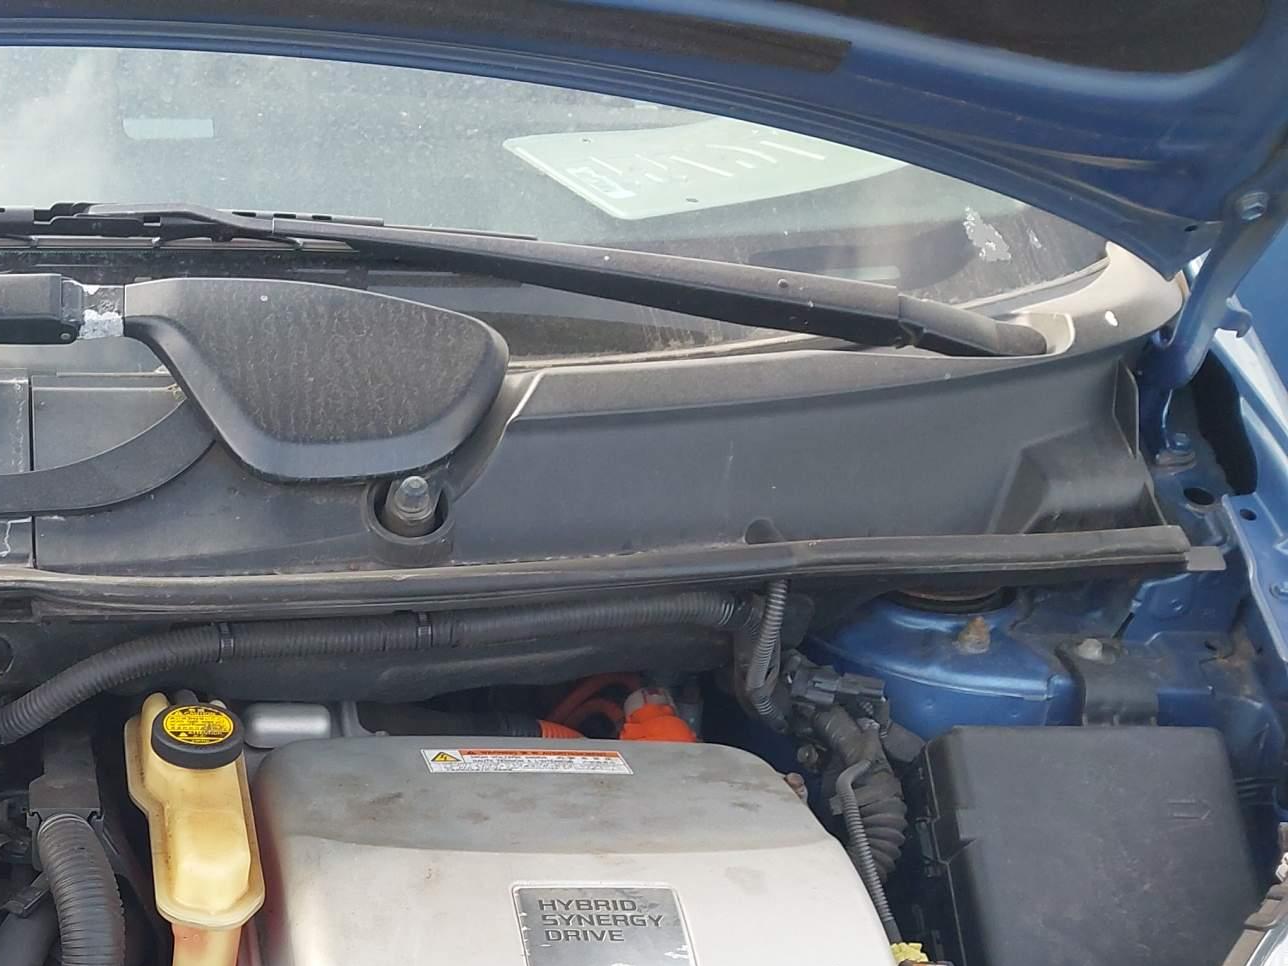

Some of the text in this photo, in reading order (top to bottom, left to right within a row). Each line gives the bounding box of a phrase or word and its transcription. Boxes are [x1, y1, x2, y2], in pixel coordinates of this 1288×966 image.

[538, 899, 637, 911] HYBRID
[541, 914, 664, 927] SYNERGY
[545, 929, 625, 942] DRIVE
